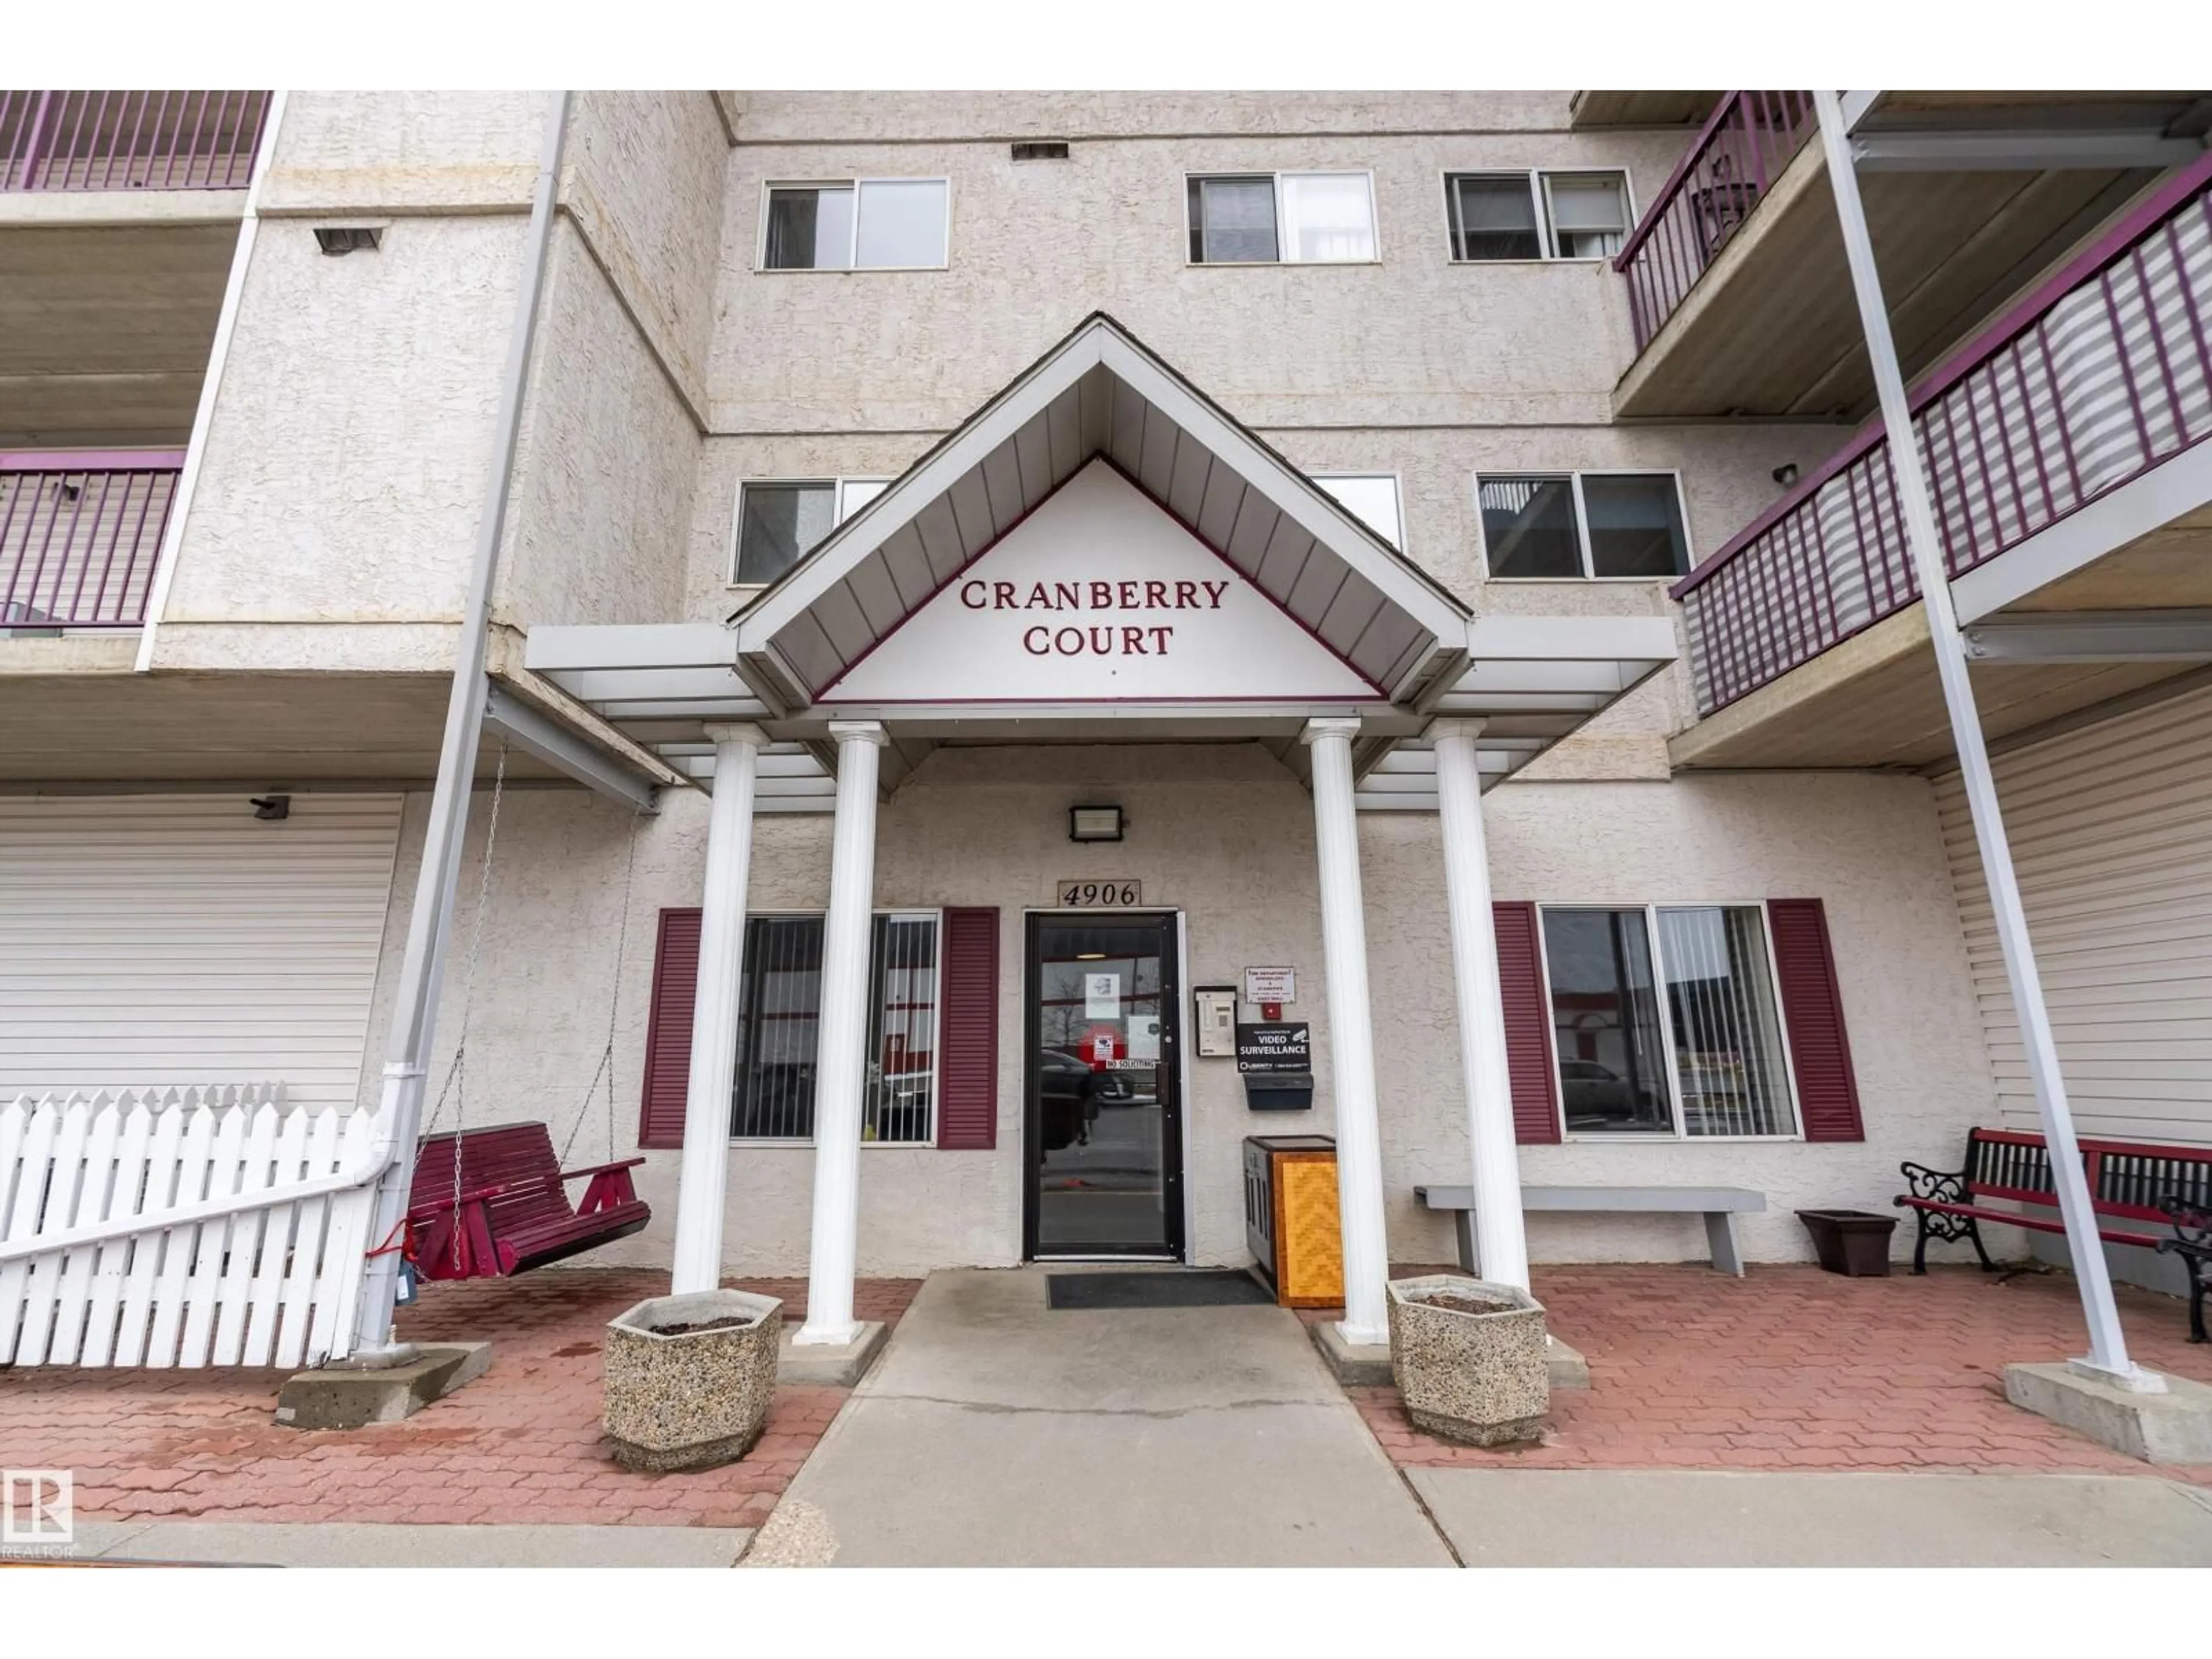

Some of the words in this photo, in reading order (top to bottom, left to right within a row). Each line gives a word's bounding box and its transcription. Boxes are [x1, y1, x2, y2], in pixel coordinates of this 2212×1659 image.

[961, 580, 1229, 610] CRANBERRY
[1023, 626, 1173, 656] COURT
[1063, 884, 1135, 905] 4906
[1258, 1036, 1287, 1044] VIDEO
[1240, 1046, 1306, 1055] SURVEILLANCE
[1107, 1060, 1115, 1068] NO
